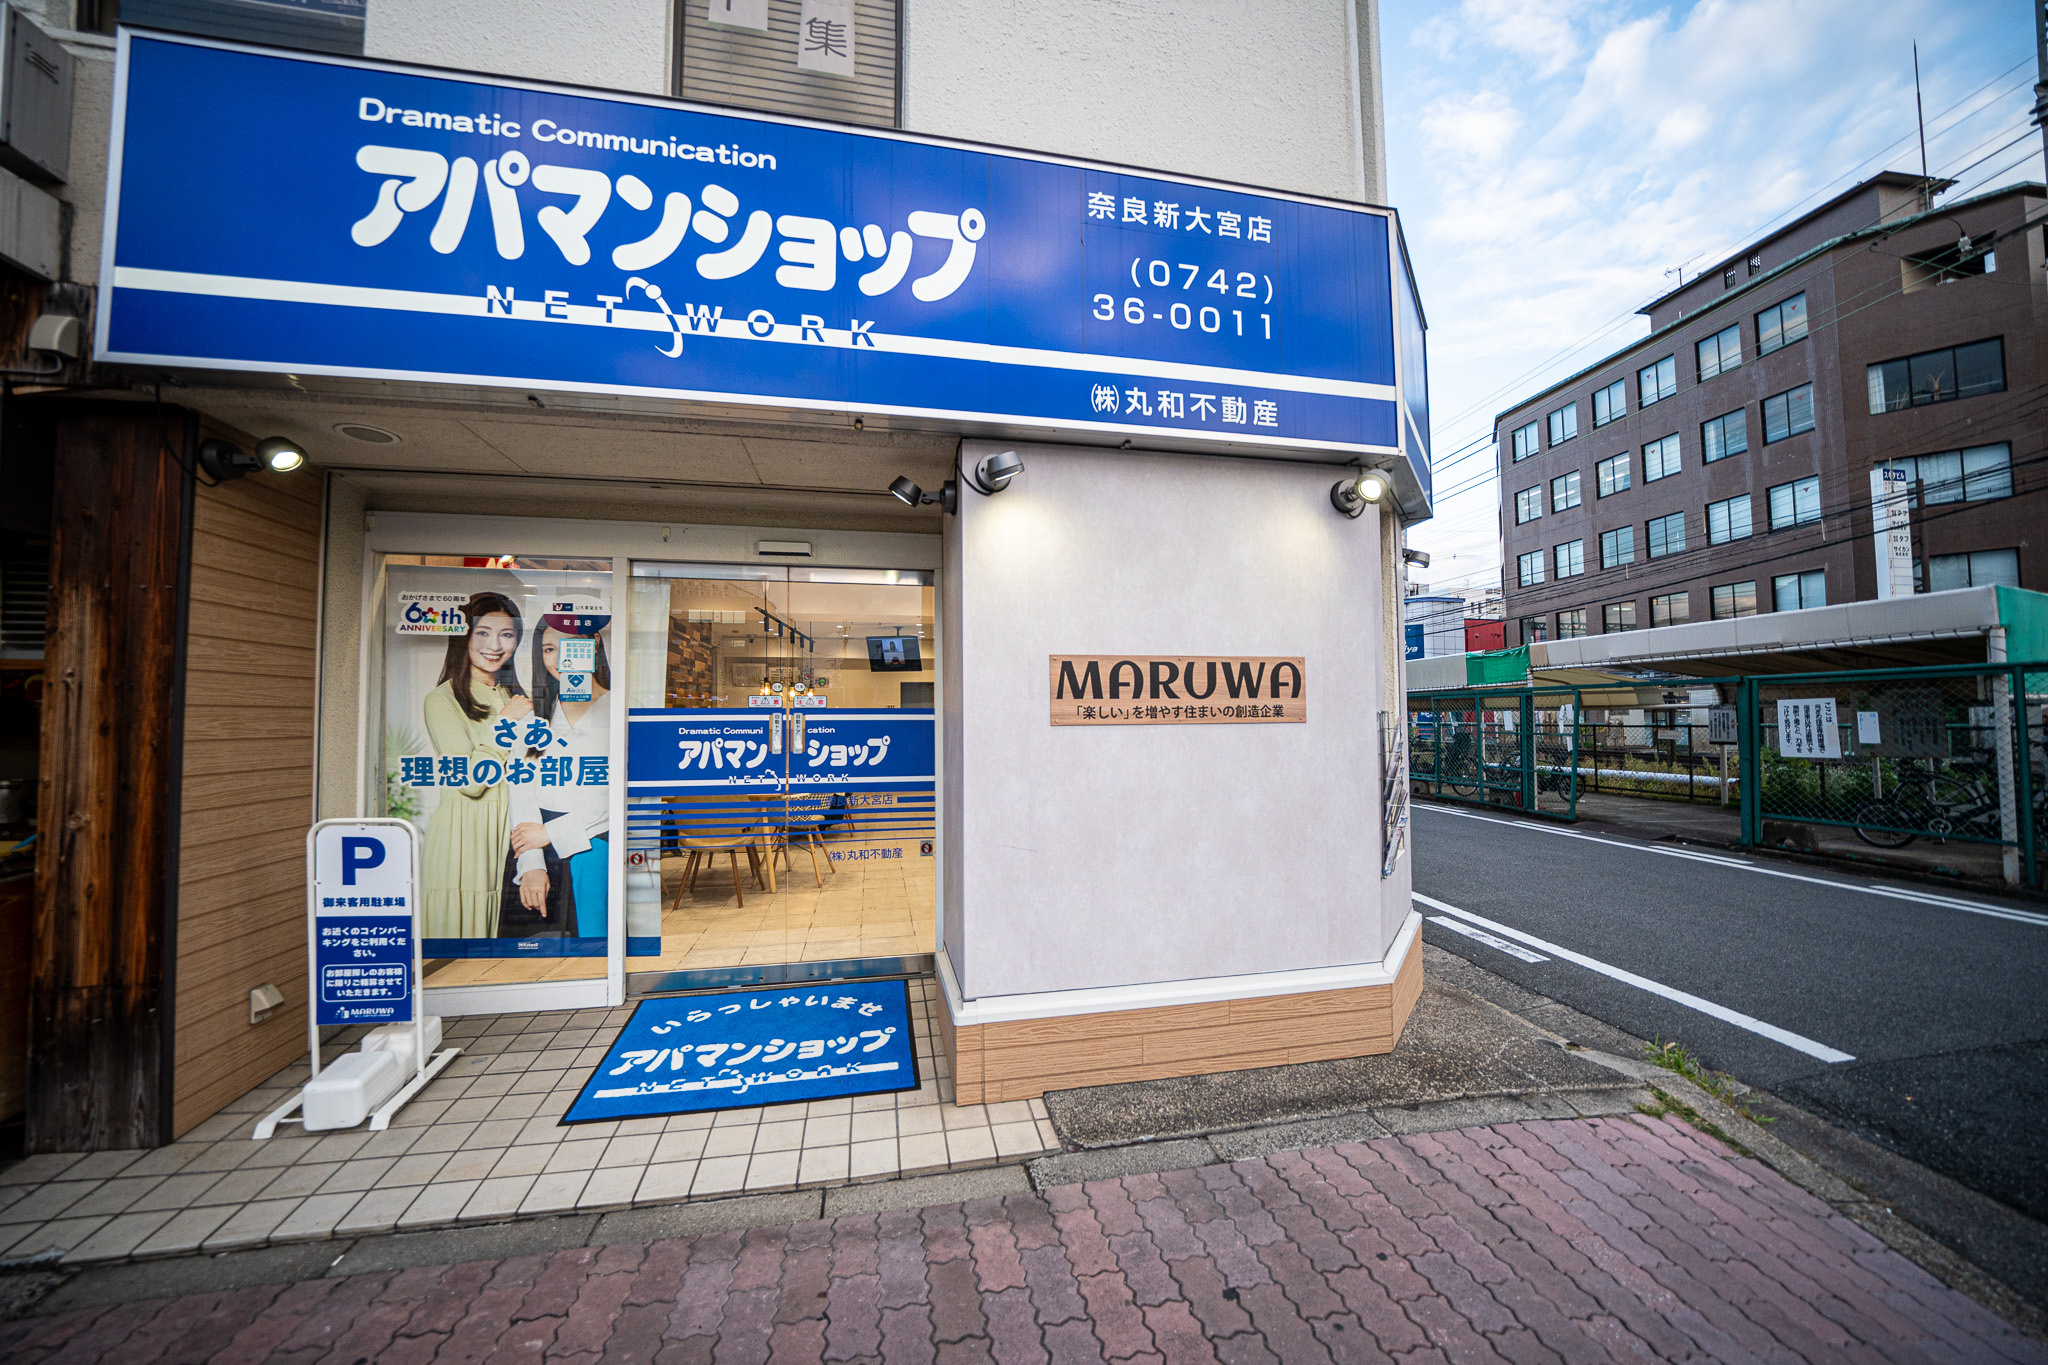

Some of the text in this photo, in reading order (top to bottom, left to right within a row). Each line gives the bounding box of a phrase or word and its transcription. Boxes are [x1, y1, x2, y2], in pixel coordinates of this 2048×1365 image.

[357, 96, 779, 171] Dramatic Communication
[350, 144, 987, 303] アパマンショップ
[1086, 190, 1273, 245] 奈良新大宮店
[1128, 256, 1275, 306] (0742)
[1091, 293, 1273, 341] 36-0011
[401, 593, 467, 603] おかげさまで60周年
[399, 623, 467, 633] ANNIVERSARY
[563, 619, 592, 627] 取扱店
[1055, 660, 1303, 700] MARUWA
[1075, 704, 1285, 720] 「楽しい」を増やす住まいの創造企業
[494, 718, 569, 749] さあ、
[678, 726, 764, 735] Dramatic Communi
[806, 725, 836, 734] cation
[678, 738, 768, 770] アパマン
[807, 735, 891, 767] ショップ
[400, 755, 610, 788] 理想のお部屋
[341, 836, 387, 886] P
[322, 896, 406, 908] 御来客用駐車場
[321, 937, 407, 947] キングをご利用くだ
[322, 927, 406, 937] お近くのコインパー
[353, 949, 377, 958] さい。
[336, 987, 393, 997] いただきます。
[350, 1007, 395, 1016] MARUWA
[651, 994, 885, 1036] いらっしゃいませ
[608, 1026, 897, 1077] アパマンショップ
